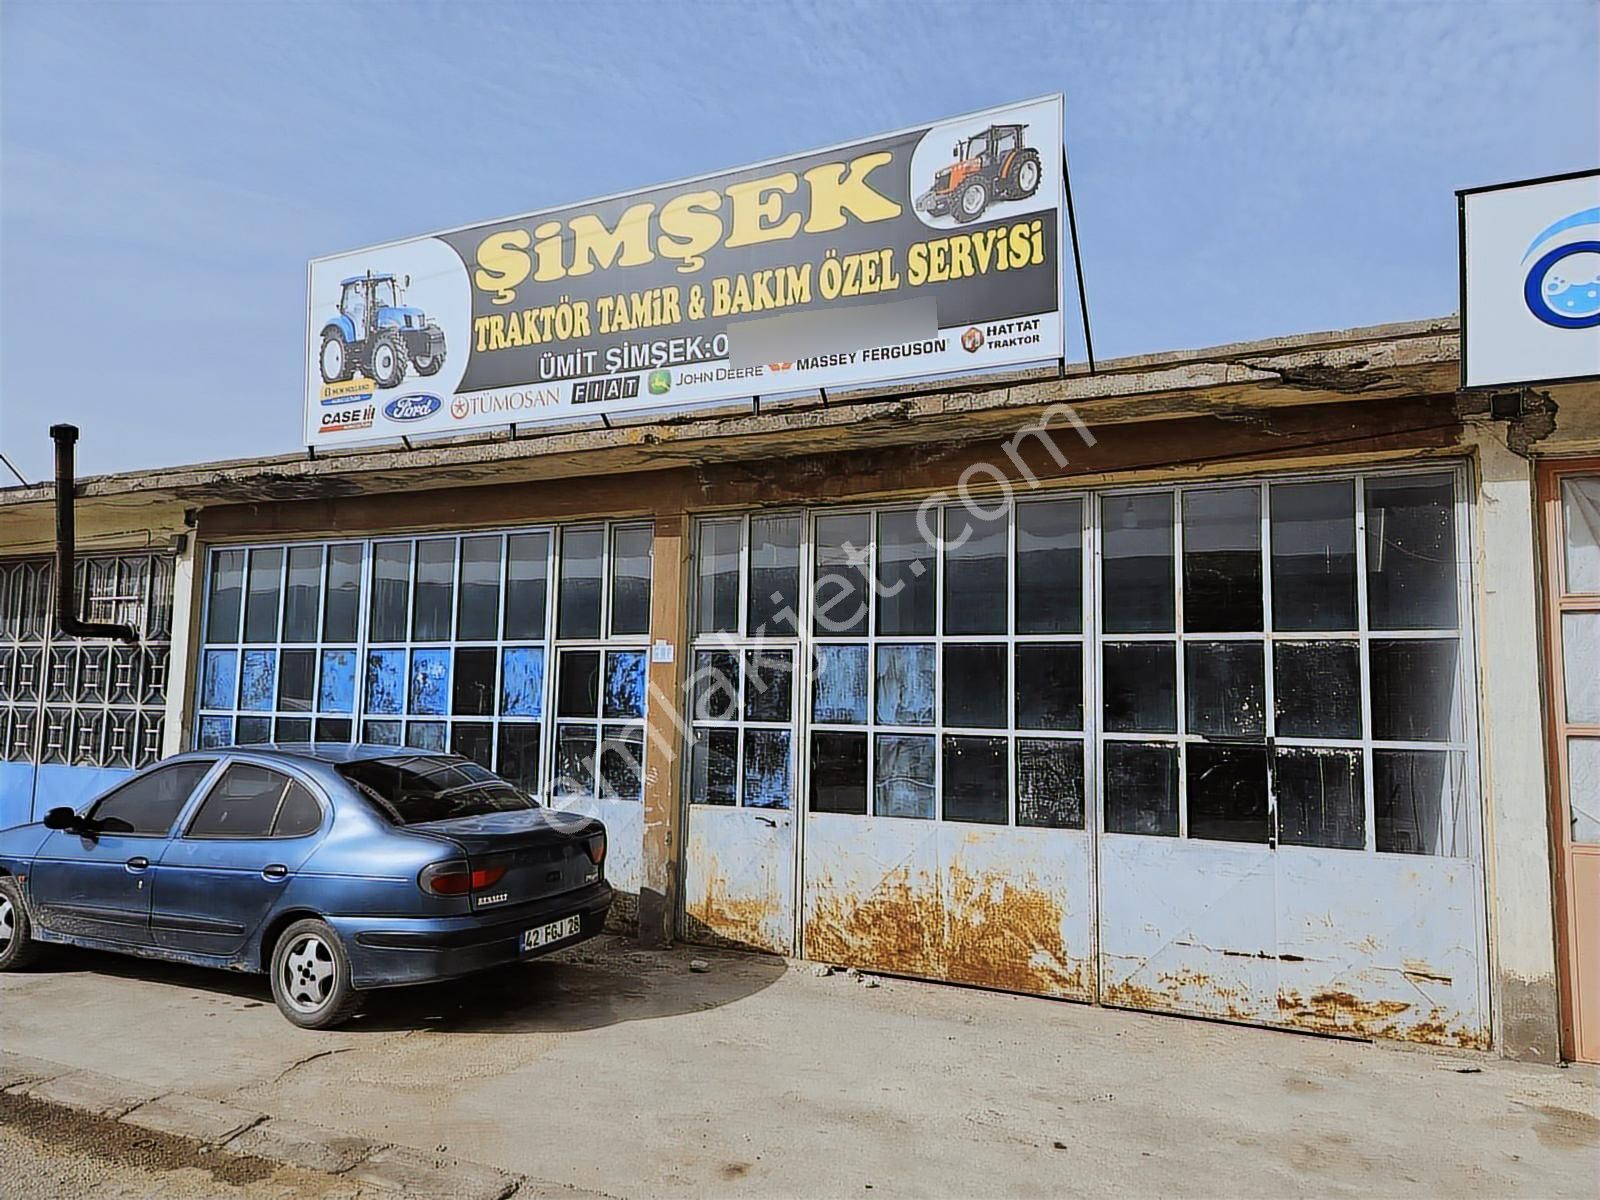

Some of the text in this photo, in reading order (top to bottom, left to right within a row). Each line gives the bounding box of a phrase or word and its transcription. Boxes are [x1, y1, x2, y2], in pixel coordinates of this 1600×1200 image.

[474, 296, 591, 352] TRAKTÖR
[688, 284, 705, 320] &
[711, 263, 811, 317] BAKIM
[819, 249, 900, 299] ÖZEL
[986, 319, 1041, 337] HATTAT
[987, 334, 1040, 350] TRAKTOR
[540, 350, 598, 379] ÜMİT
[796, 339, 946, 371] MASSEY FERGUSON
[470, 387, 560, 416] TÜMOSAN
[572, 375, 640, 404] FIAT
[322, 410, 361, 425] CASE
[393, 397, 432, 418] Ford
[526, 931, 540, 947] 42
